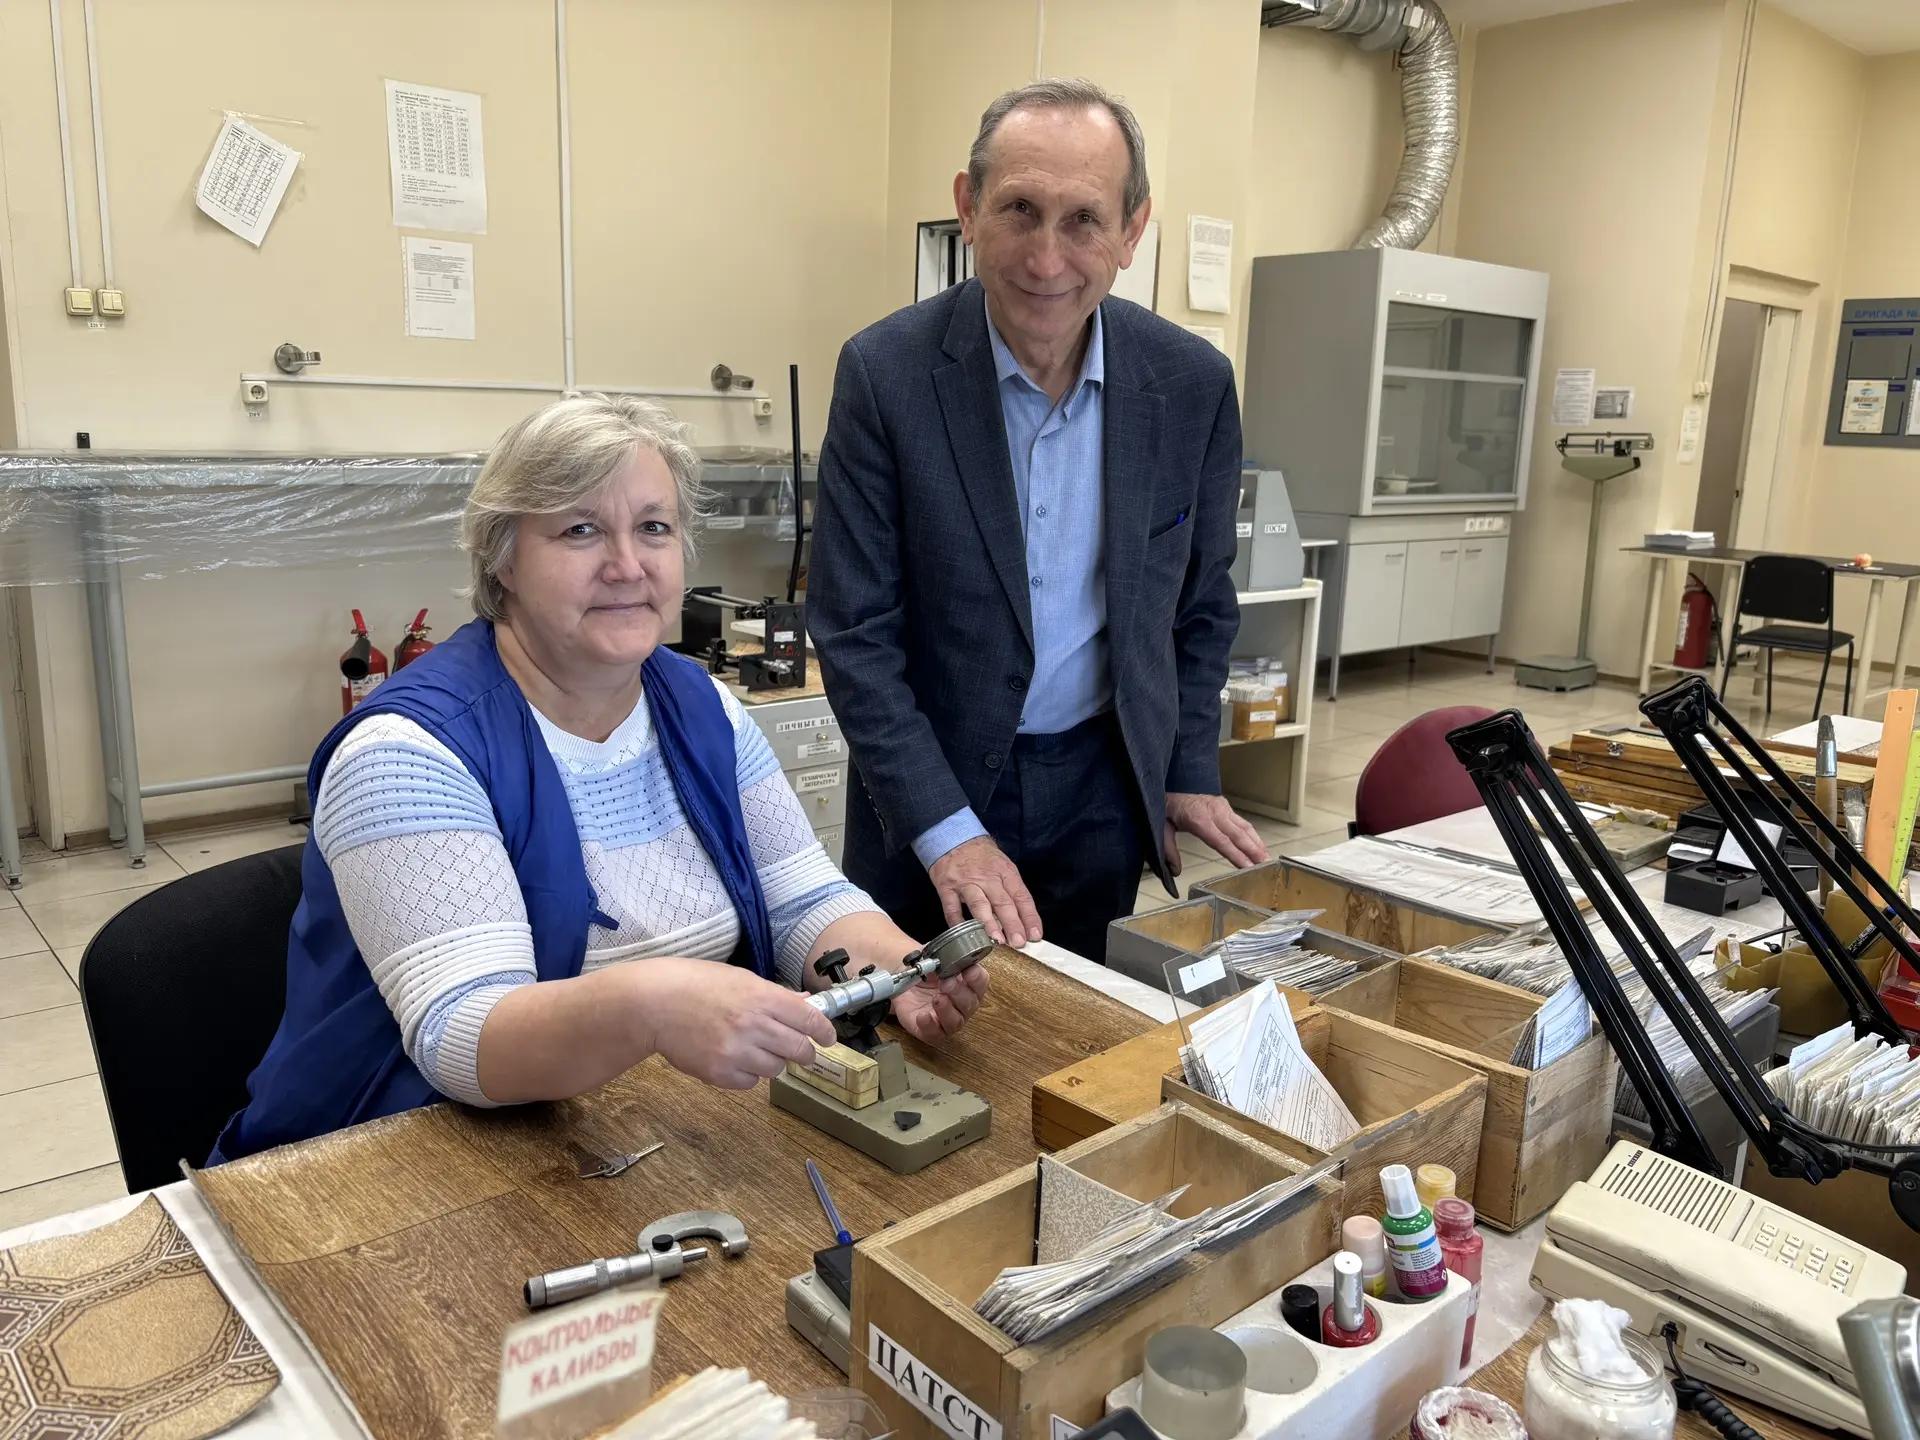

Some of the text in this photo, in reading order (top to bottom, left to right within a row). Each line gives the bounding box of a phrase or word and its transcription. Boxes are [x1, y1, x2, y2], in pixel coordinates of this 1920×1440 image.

[778, 719, 815, 731] ЛИЧНЫЕ
[507, 1298, 653, 1371] КОНТРОЛЬНЫЕ
[530, 1333, 638, 1396] КАЛИБРЫ
[876, 1333, 991, 1440] ЦАТСТ
